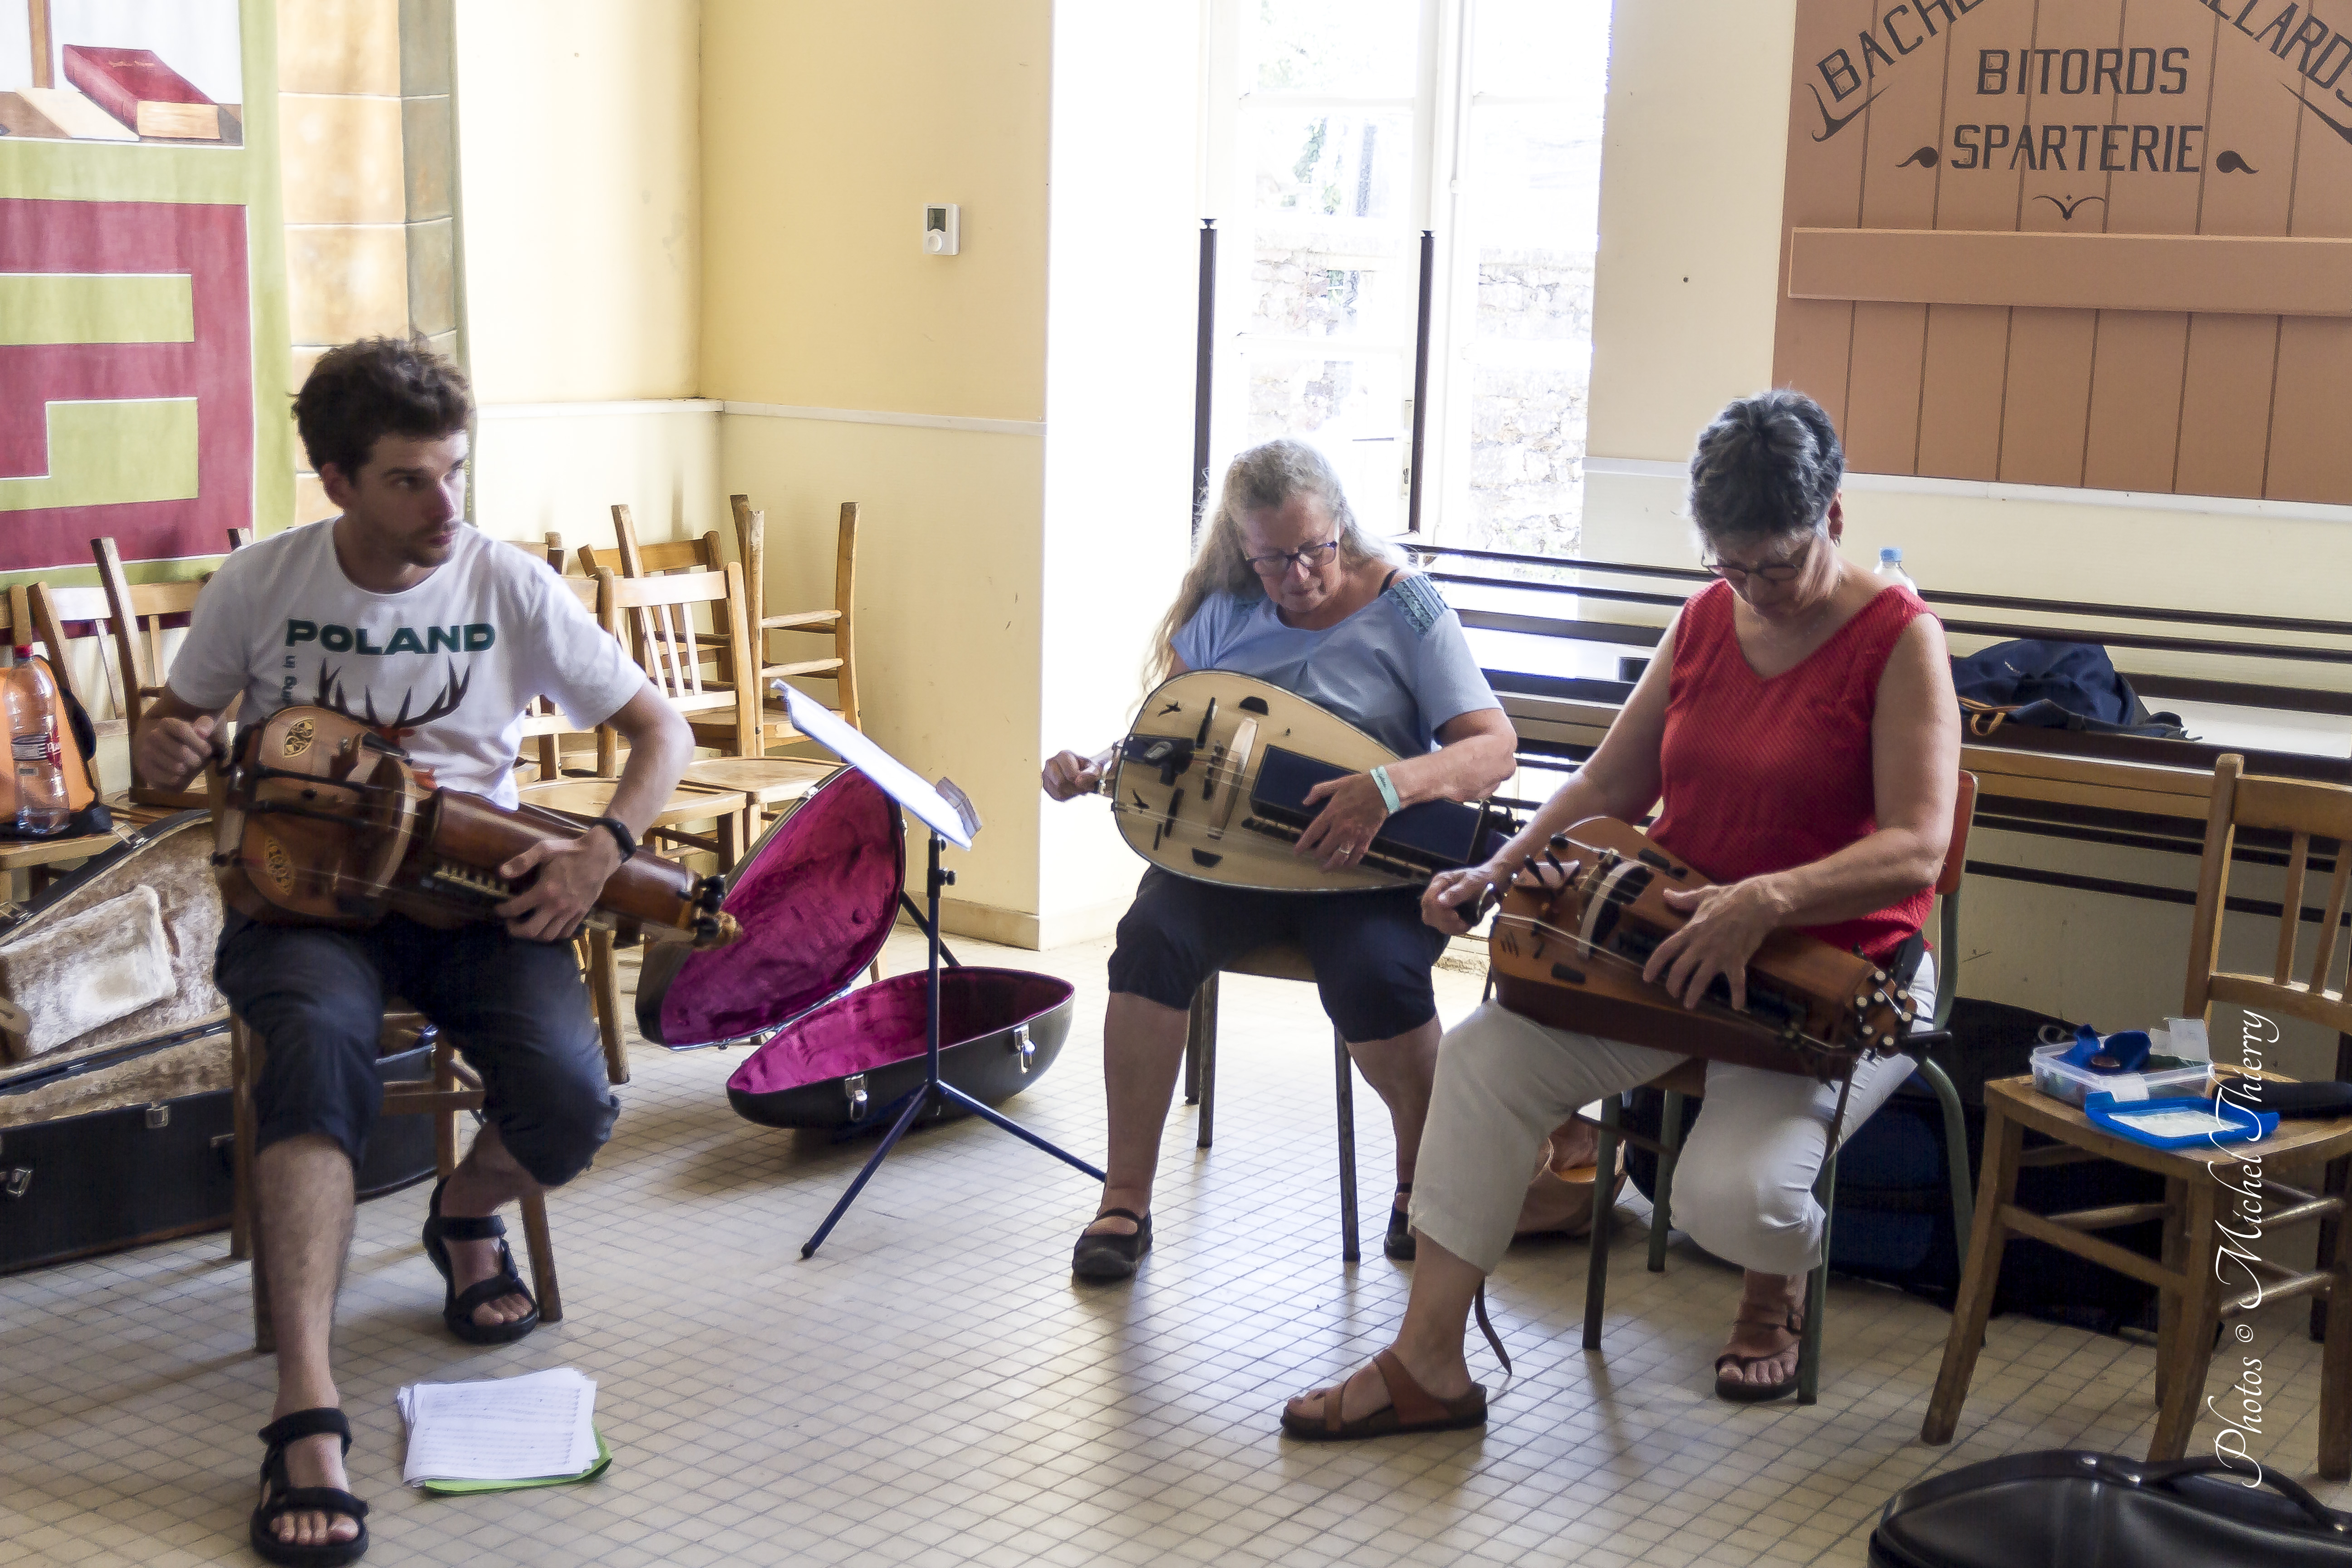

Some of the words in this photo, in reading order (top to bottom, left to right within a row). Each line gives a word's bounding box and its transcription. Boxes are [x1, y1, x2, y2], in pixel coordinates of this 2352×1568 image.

[1976, 47, 2190, 95] BITORDS
[1951, 124, 2204, 172] SPARTERIE
[285, 618, 496, 655] POLAND
